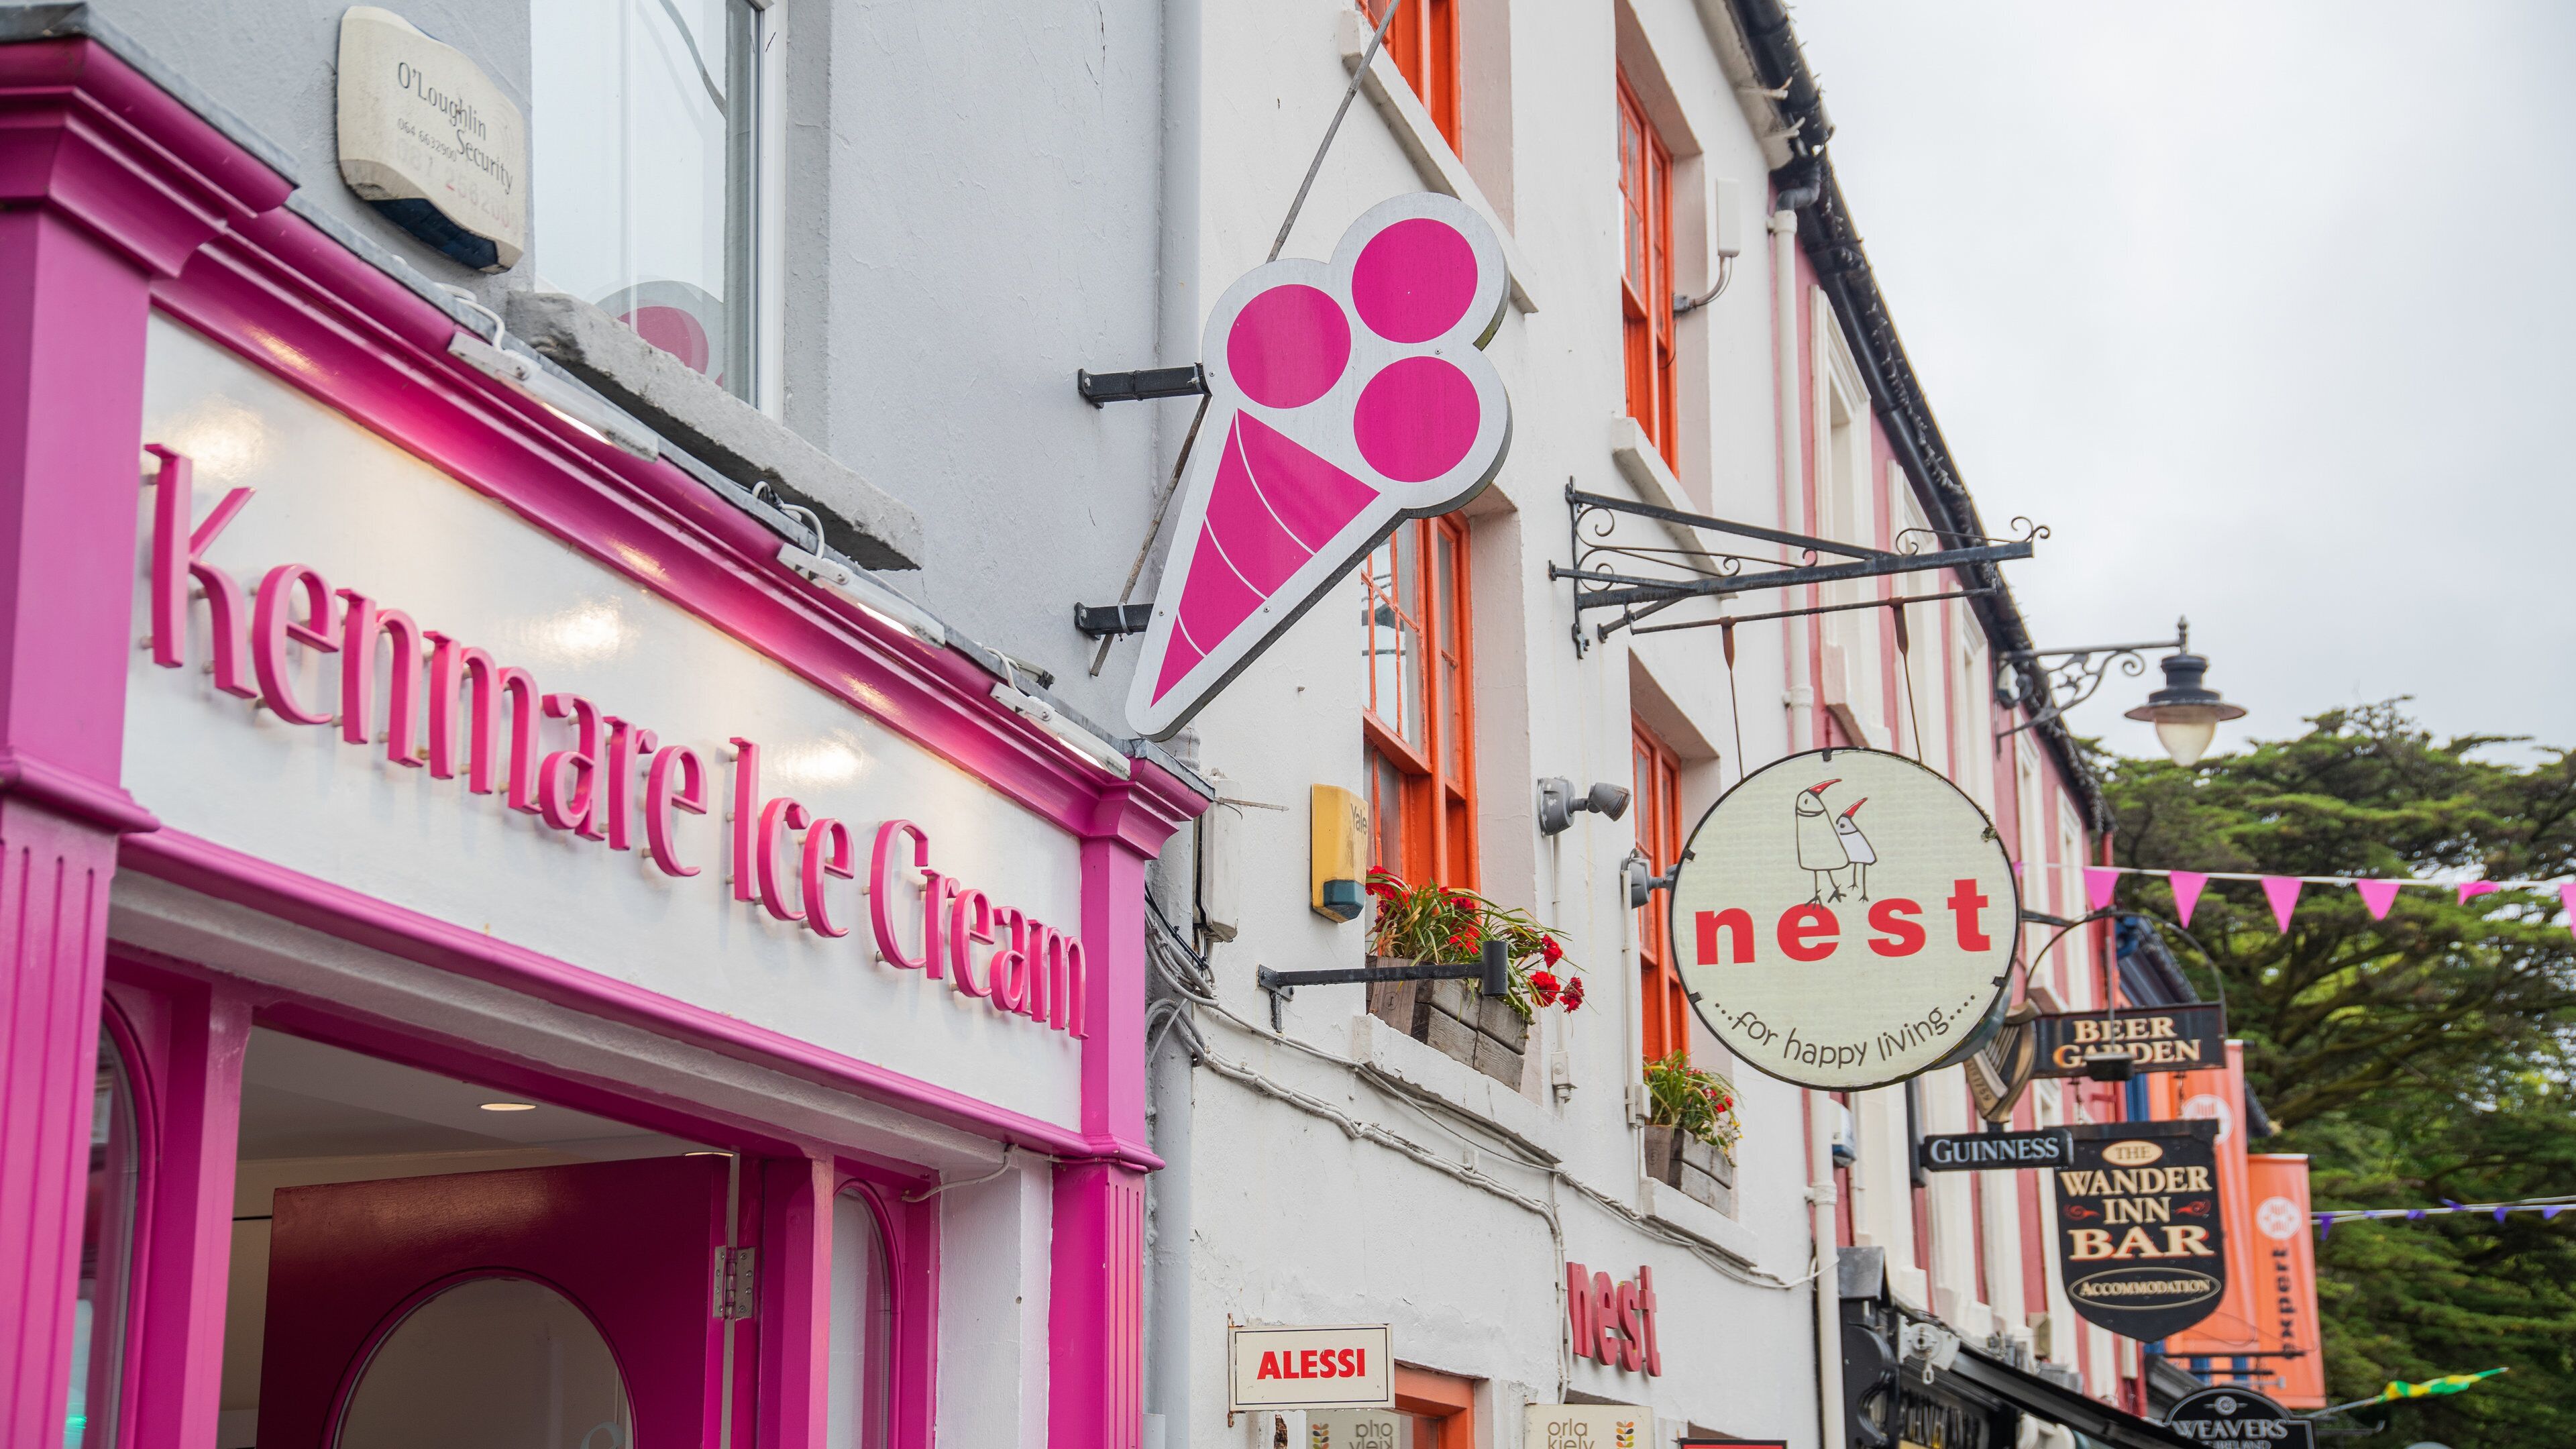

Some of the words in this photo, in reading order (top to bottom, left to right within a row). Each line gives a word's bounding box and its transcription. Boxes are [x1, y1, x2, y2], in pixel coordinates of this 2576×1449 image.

[398, 62, 486, 140] O'Loughlin
[398, 118, 415, 136] 064
[457, 129, 513, 195] Security
[144, 443, 708, 877] Kenmare
[730, 737, 854, 938] Ice
[870, 819, 1089, 1040] Cream
[1351, 803, 1368, 835] Yale
[1695, 879, 1991, 965] nest
[2072, 1016, 2178, 1043] BEER
[1784, 1028, 1867, 1069] happy
[1930, 1137, 2059, 1164] GUINNESS
[2114, 1145, 2153, 1160] THE
[2059, 1166, 2212, 1197] WANDER
[2102, 1197, 2171, 1224] INN
[2067, 1225, 2217, 1261] BAR
[1566, 1262, 1662, 1377] nest
[1256, 1348, 1366, 1380] ALESSI
[1548, 1418, 1587, 1436] orla
[2171, 1419, 2288, 1439] WEAVERS
